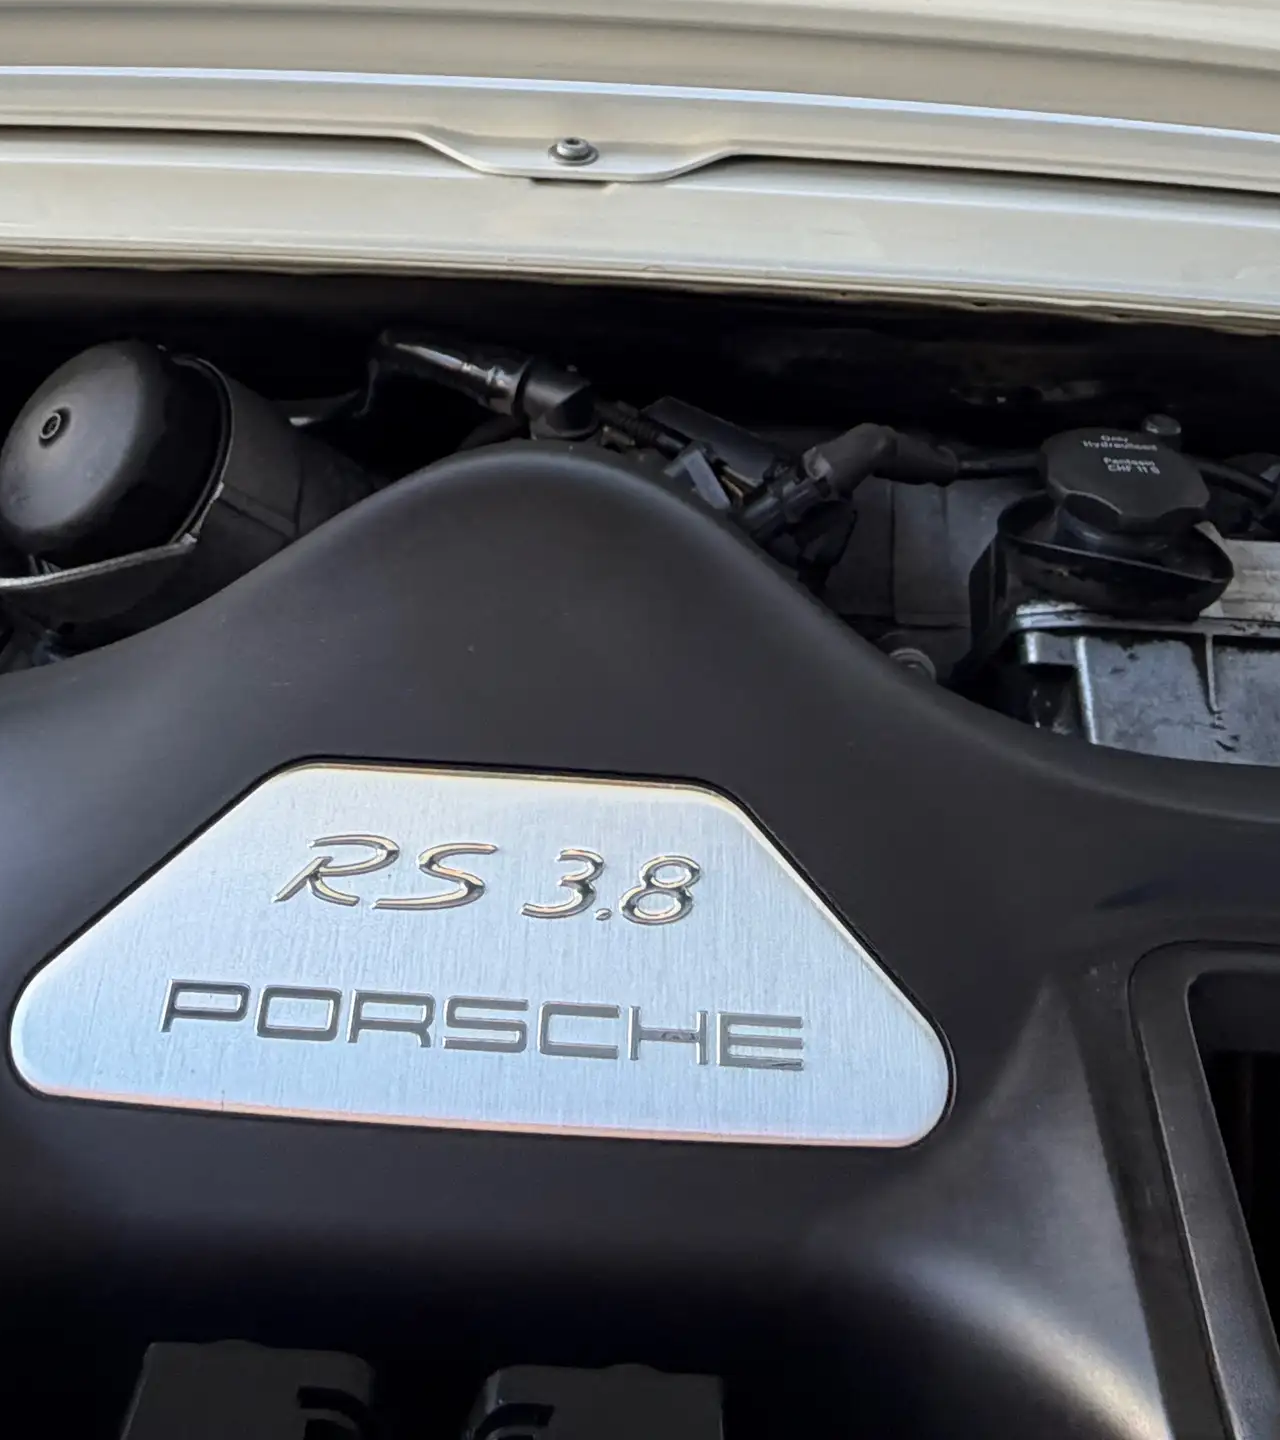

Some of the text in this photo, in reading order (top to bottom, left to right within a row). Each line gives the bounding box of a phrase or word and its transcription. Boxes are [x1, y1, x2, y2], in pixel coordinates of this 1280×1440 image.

[272, 832, 703, 927] RS 3.8
[159, 978, 805, 1072] PORSCHE
